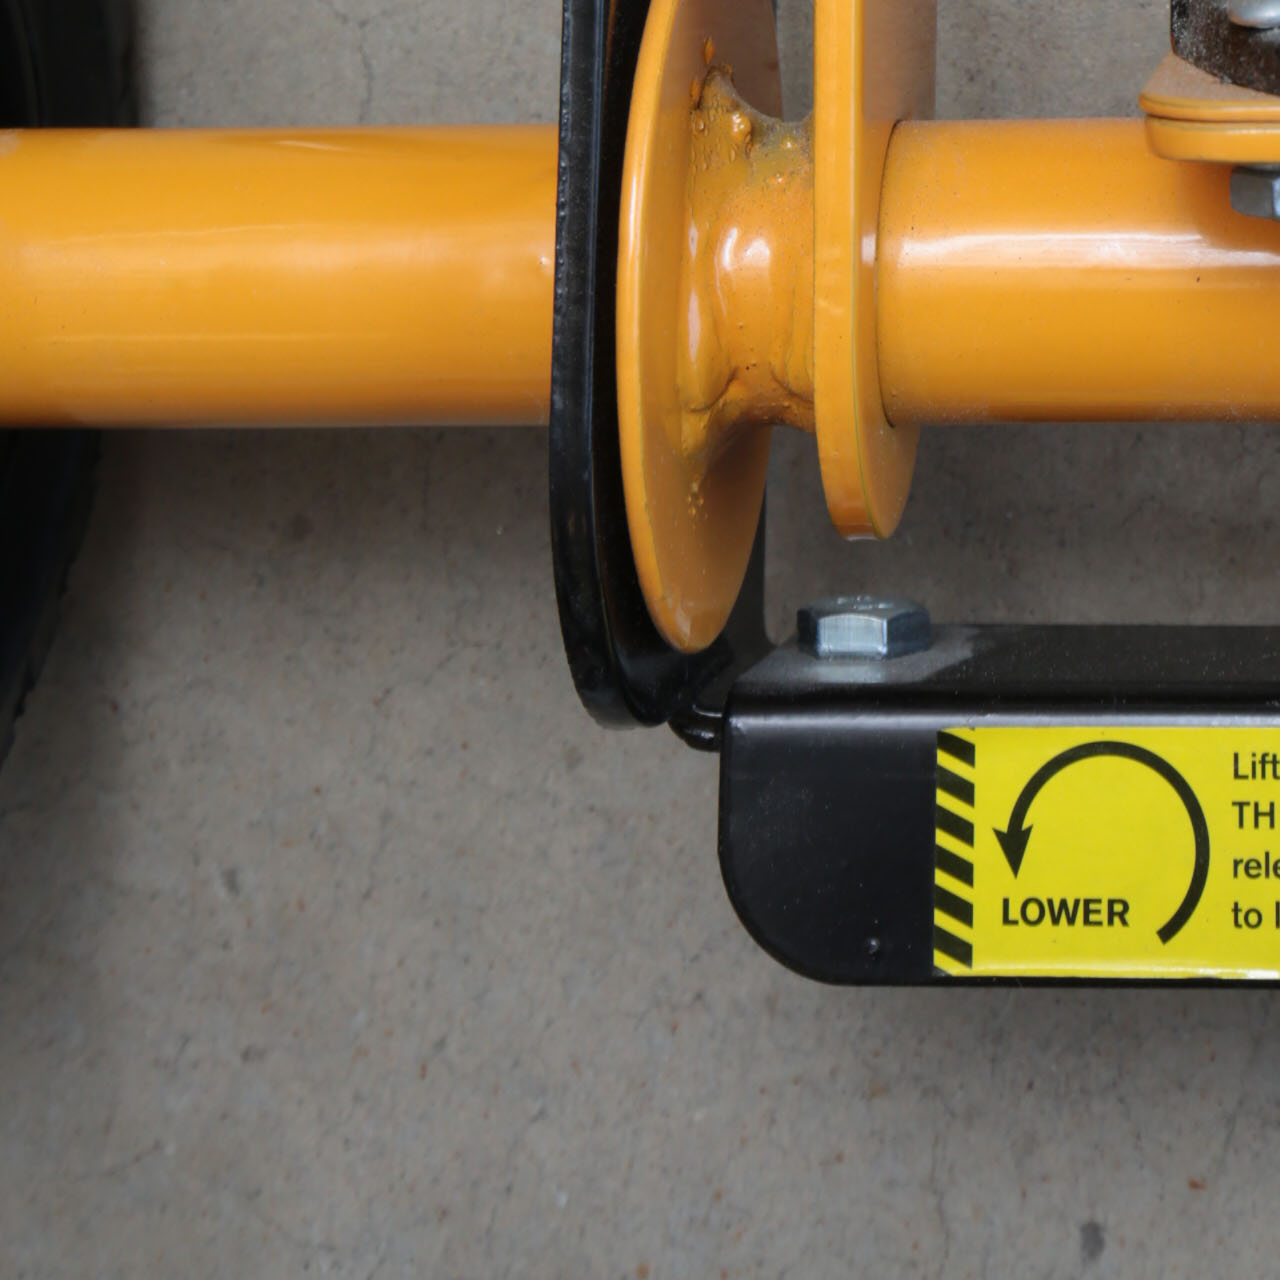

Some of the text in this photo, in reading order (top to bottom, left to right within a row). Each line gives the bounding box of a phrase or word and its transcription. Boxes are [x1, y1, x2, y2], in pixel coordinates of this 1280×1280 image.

[1233, 752, 1280, 780] Lift
[1001, 897, 1130, 928] LOWER
[1232, 901, 1263, 930] to
